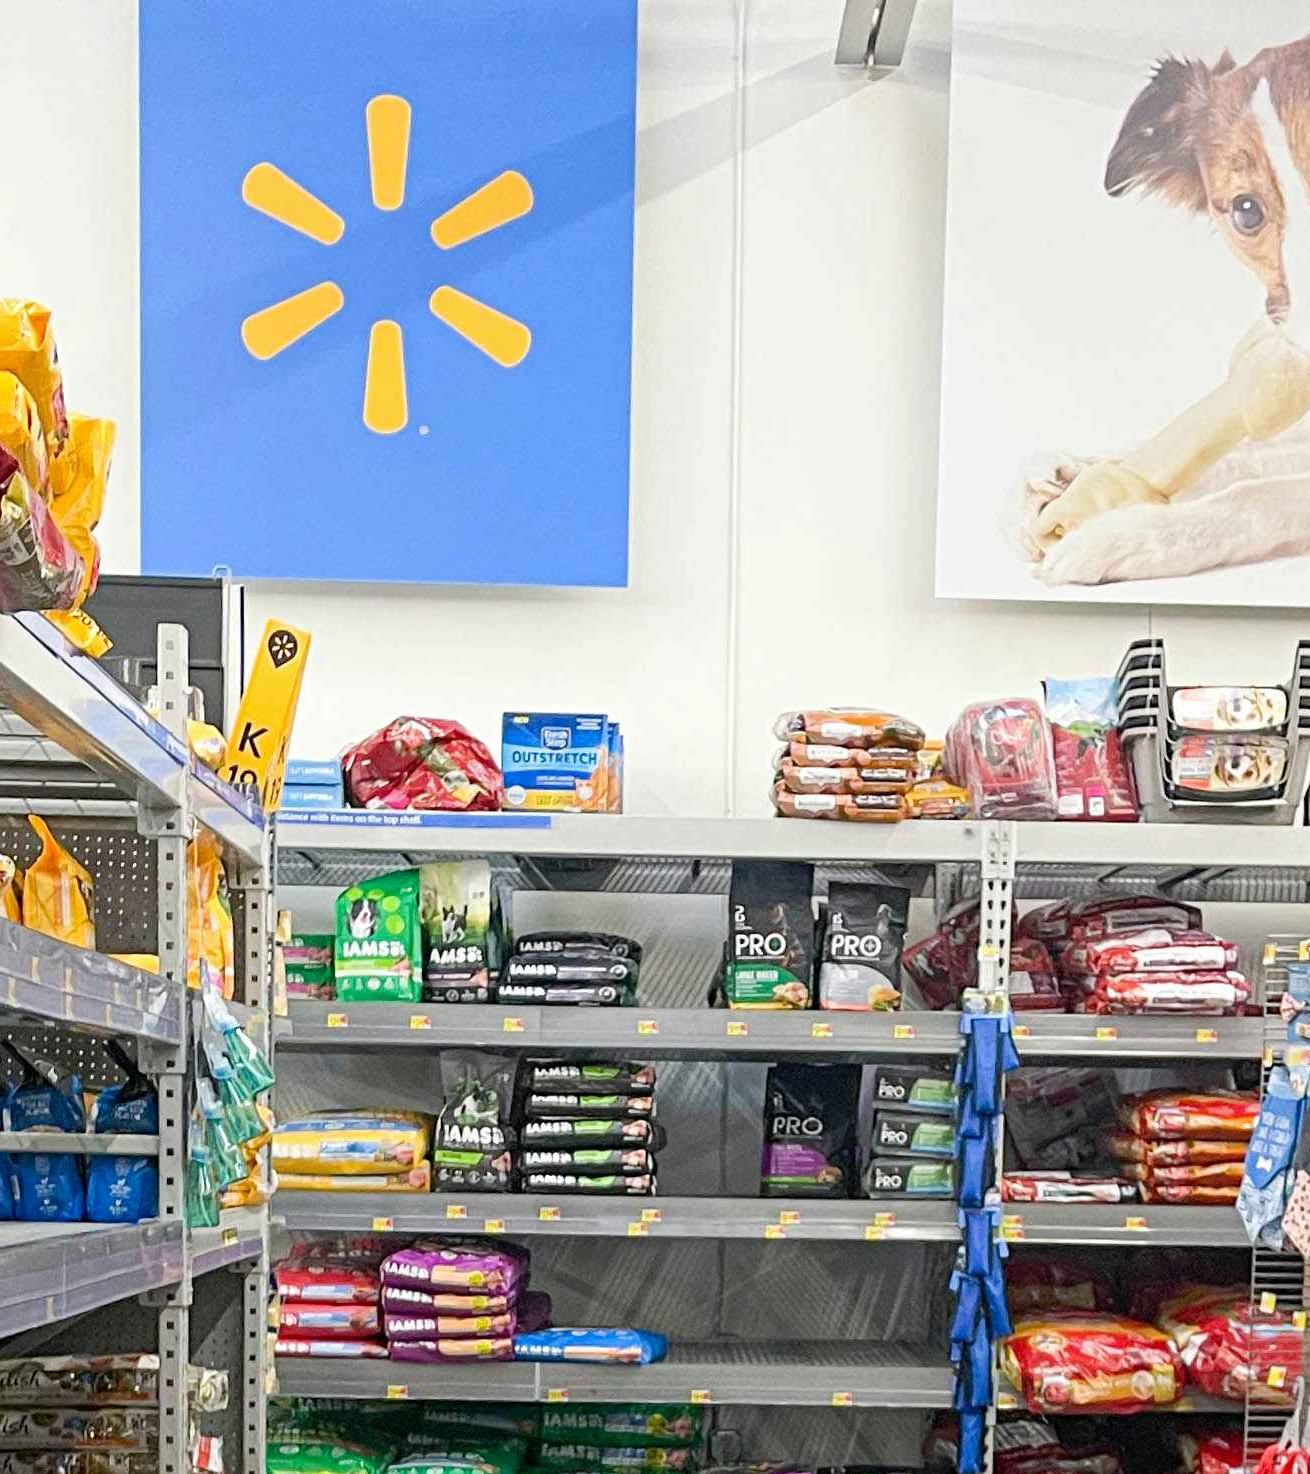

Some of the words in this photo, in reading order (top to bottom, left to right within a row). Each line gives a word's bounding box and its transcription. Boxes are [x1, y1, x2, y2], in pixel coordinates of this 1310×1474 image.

[238, 722, 267, 760] K
[512, 750, 598, 766] OUTSTRETCH
[343, 940, 392, 959] IAMS
[735, 933, 788, 958] PRO
[831, 934, 883, 959] PRO
[878, 1085, 905, 1099] PRO
[444, 1124, 490, 1145] IAMS
[772, 1116, 824, 1138] PRO
[881, 1130, 908, 1145] PRO
[874, 1174, 902, 1190] PRO
